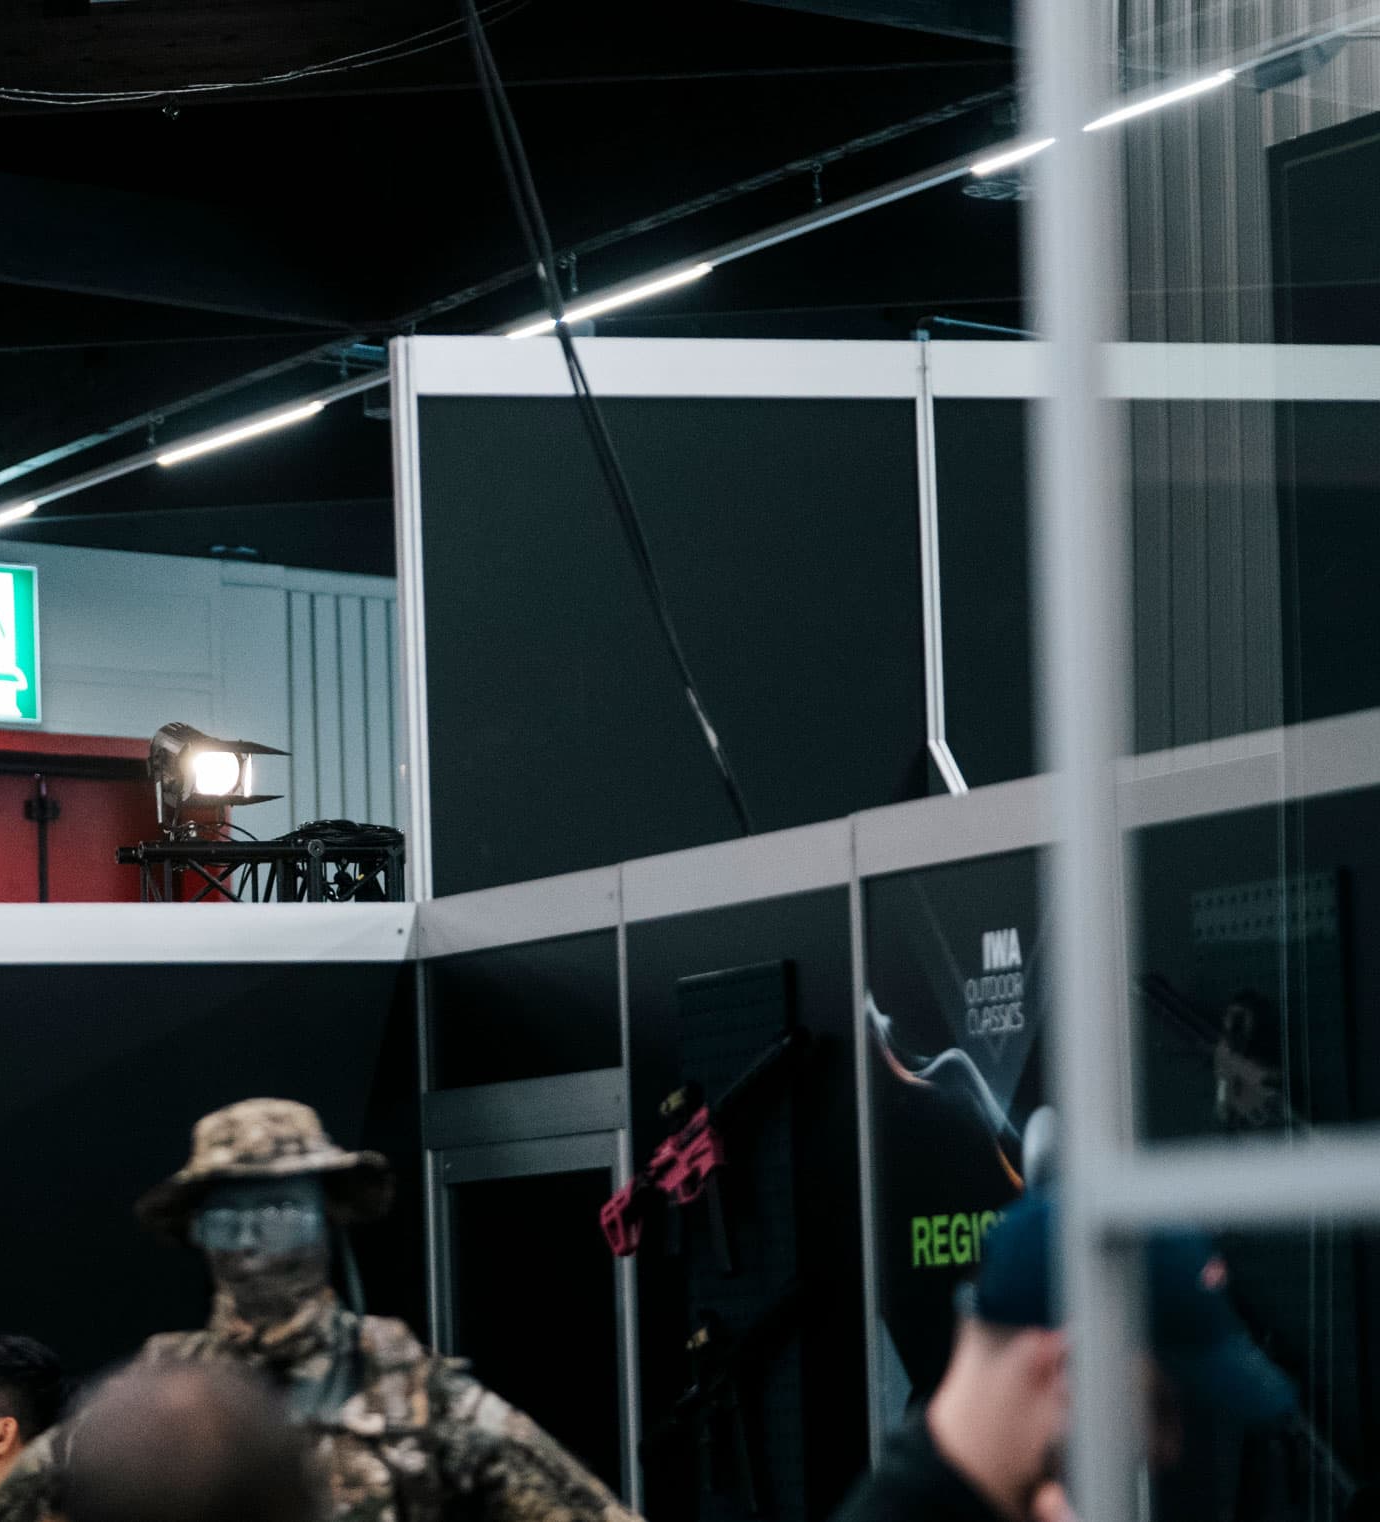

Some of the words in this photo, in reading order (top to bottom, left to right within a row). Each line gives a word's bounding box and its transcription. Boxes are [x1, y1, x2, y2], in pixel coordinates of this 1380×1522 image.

[982, 927, 1022, 971] IWA
[965, 971, 1023, 1004] OUTDOOR
[967, 1001, 1024, 1036] CLASSICS
